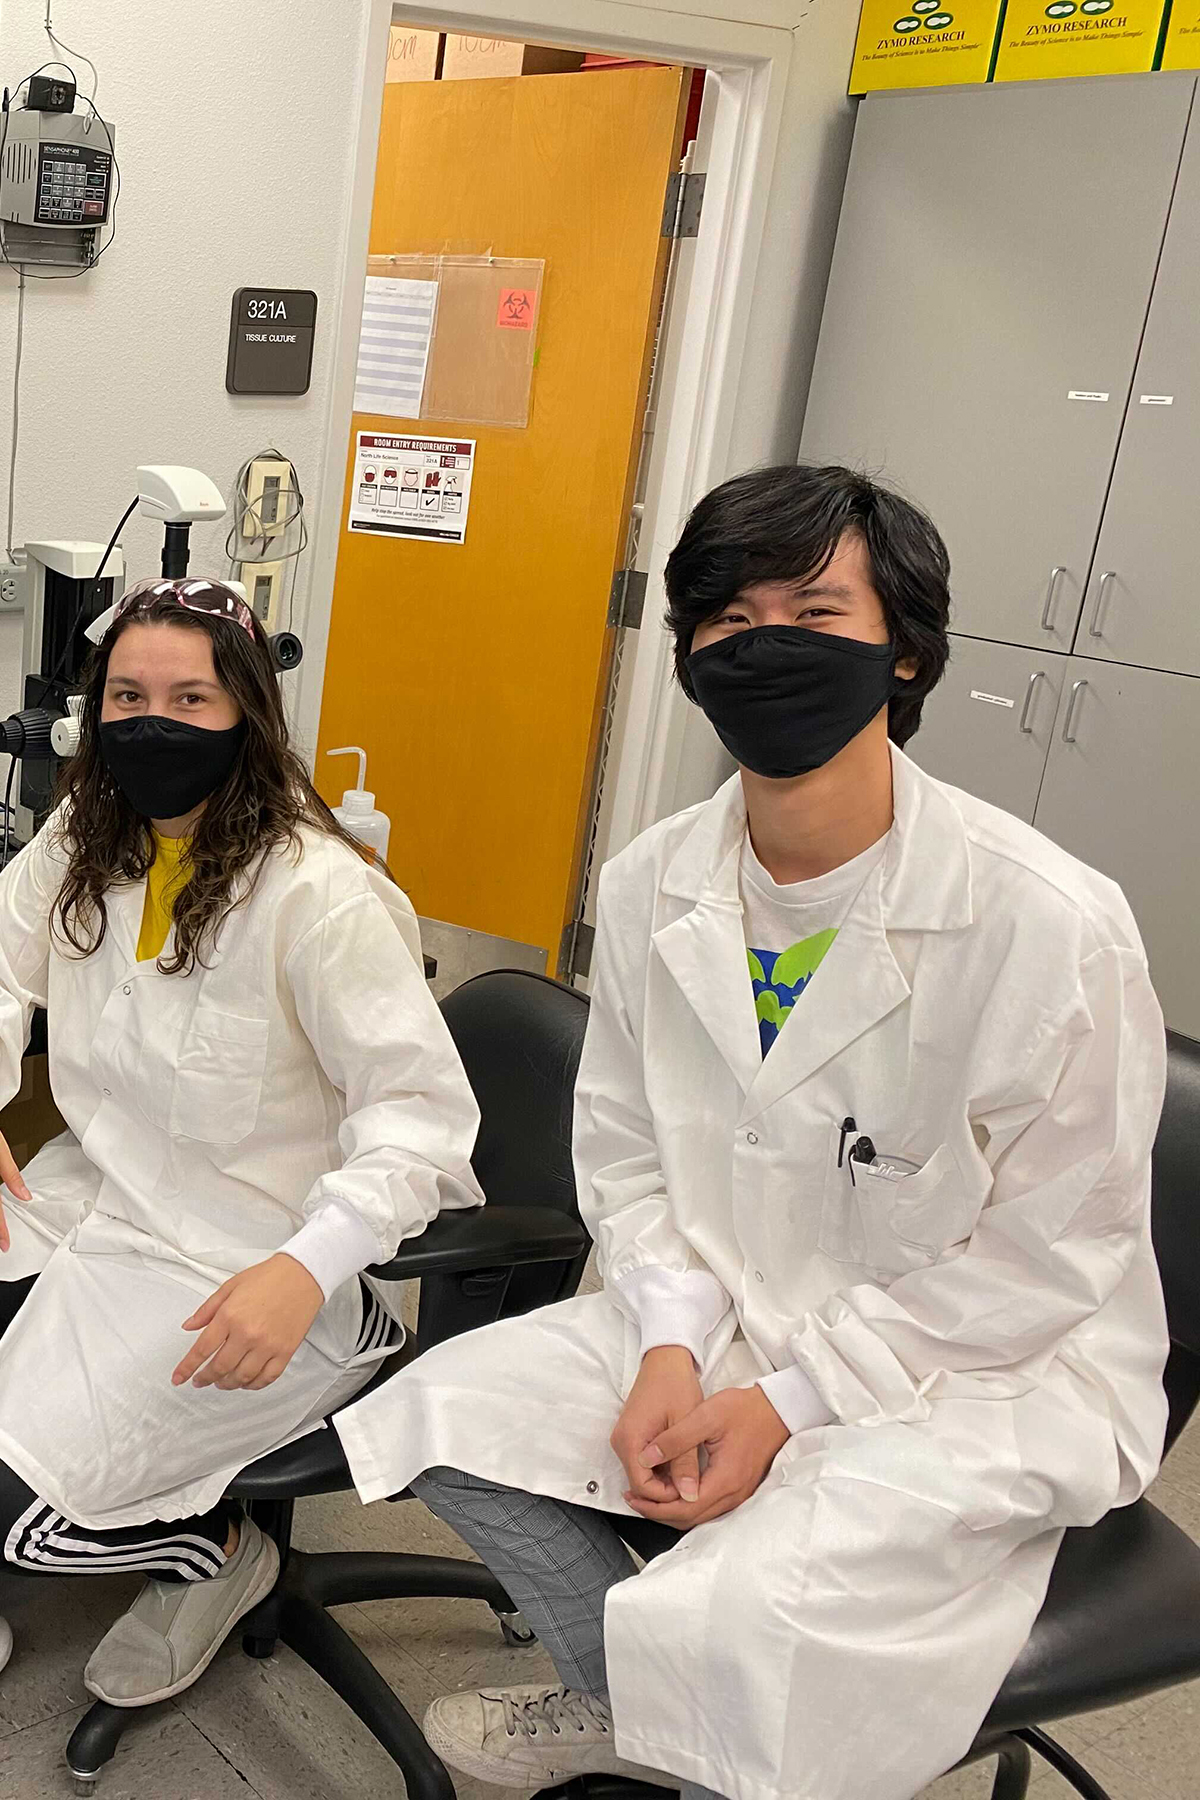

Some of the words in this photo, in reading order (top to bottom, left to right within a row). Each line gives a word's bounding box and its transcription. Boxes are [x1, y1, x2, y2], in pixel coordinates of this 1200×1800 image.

[1026, 23, 1061, 36] ZYMO
[1063, 16, 1128, 33] RESEARCH
[876, 36, 907, 50] ZYMO
[908, 30, 966, 46] RESEARCH
[1020, 38, 1039, 48] Beauty
[1046, 36, 1068, 45] Science
[1082, 33, 1099, 41] Make
[1100, 31, 1121, 40] Things
[894, 49, 914, 58] Science
[925, 46, 941, 55] Make
[942, 44, 960, 53] Things
[247, 300, 287, 320] 321A
[498, 319, 529, 329] BIOHAZARD
[245, 333, 268, 342] TISSUE
[268, 334, 297, 343] CULTURE
[373, 438, 392, 448] ROOM
[392, 440, 411, 450] ENTRY
[411, 442, 457, 453] REQUIREMENTS
